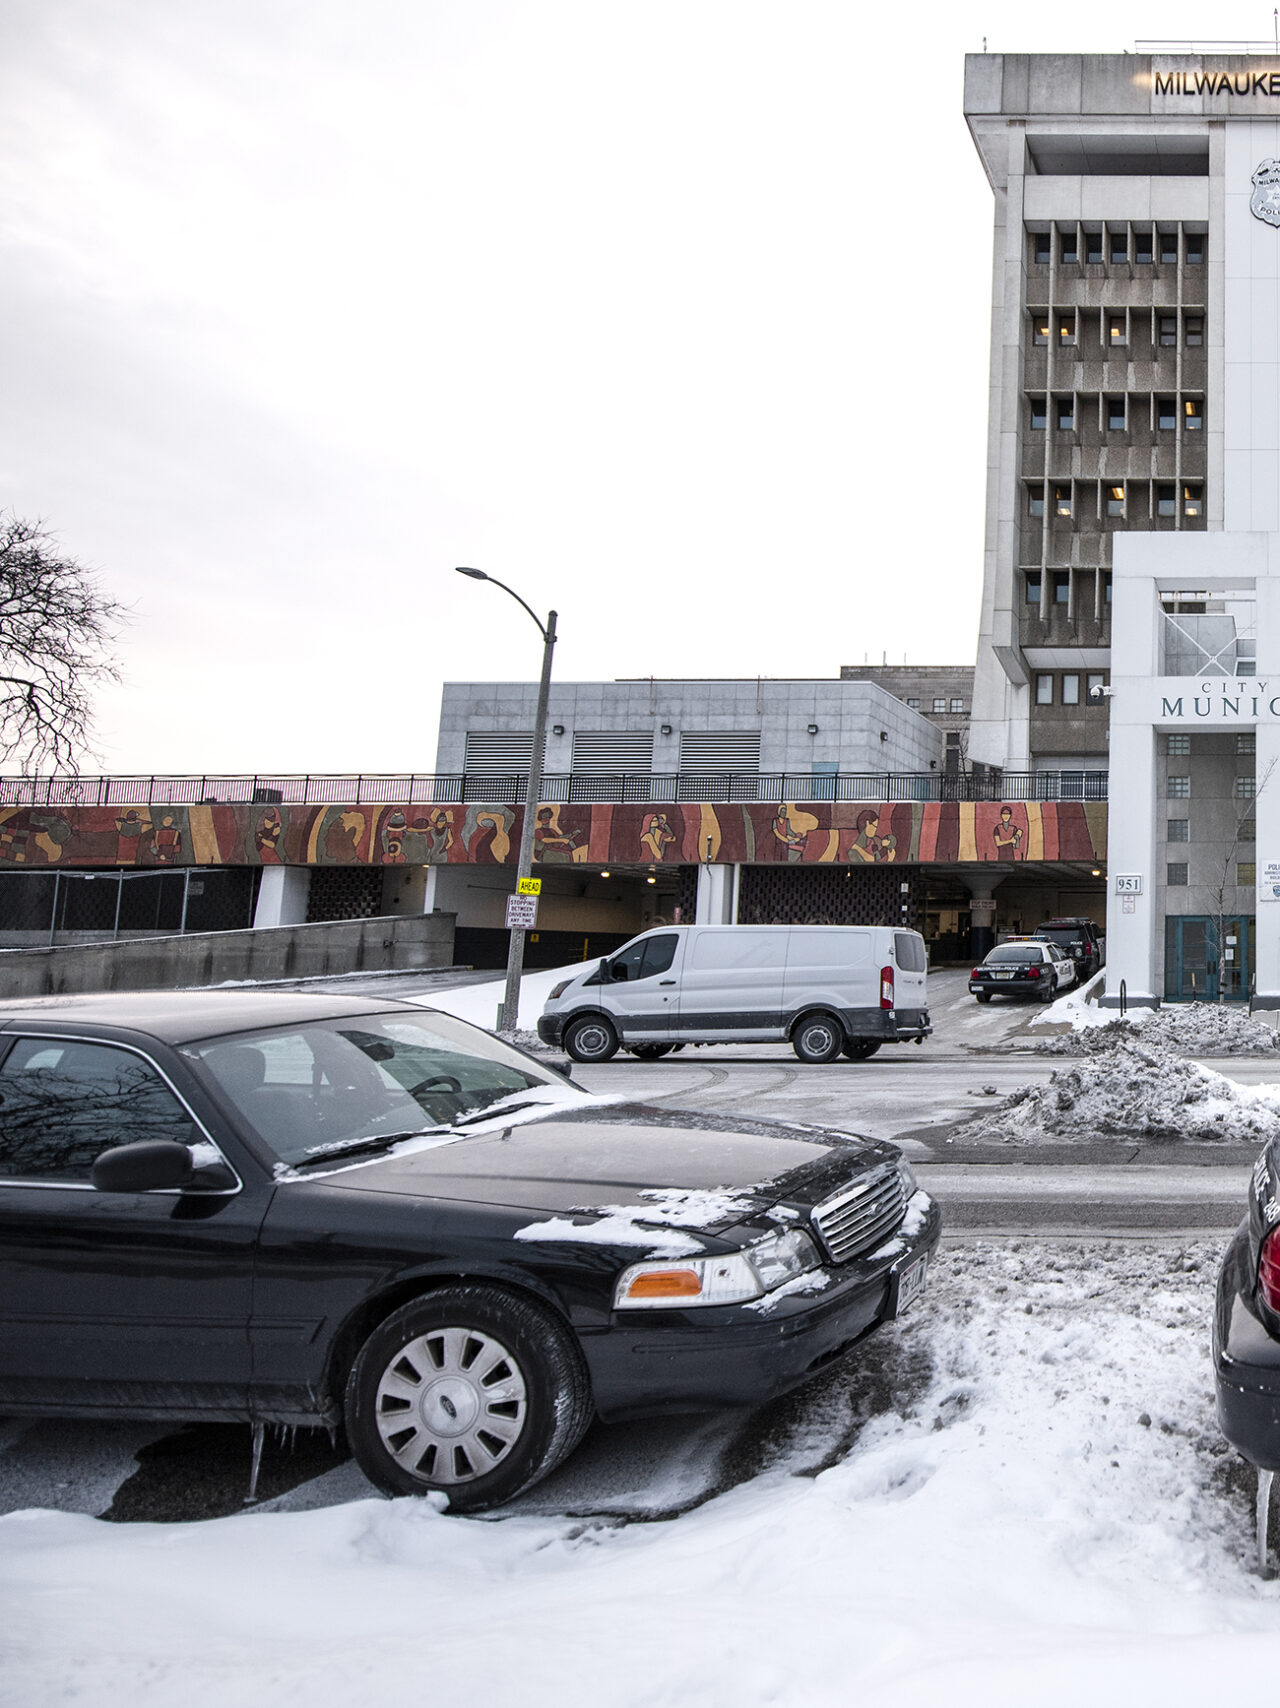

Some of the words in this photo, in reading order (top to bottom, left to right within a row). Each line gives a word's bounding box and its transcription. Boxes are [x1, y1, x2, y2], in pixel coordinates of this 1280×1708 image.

[1201, 682, 1268, 694] CITY
[521, 881, 539, 891] AHEAD
[1117, 878, 1139, 891] 951
[1263, 1195, 1280, 1223] 248
